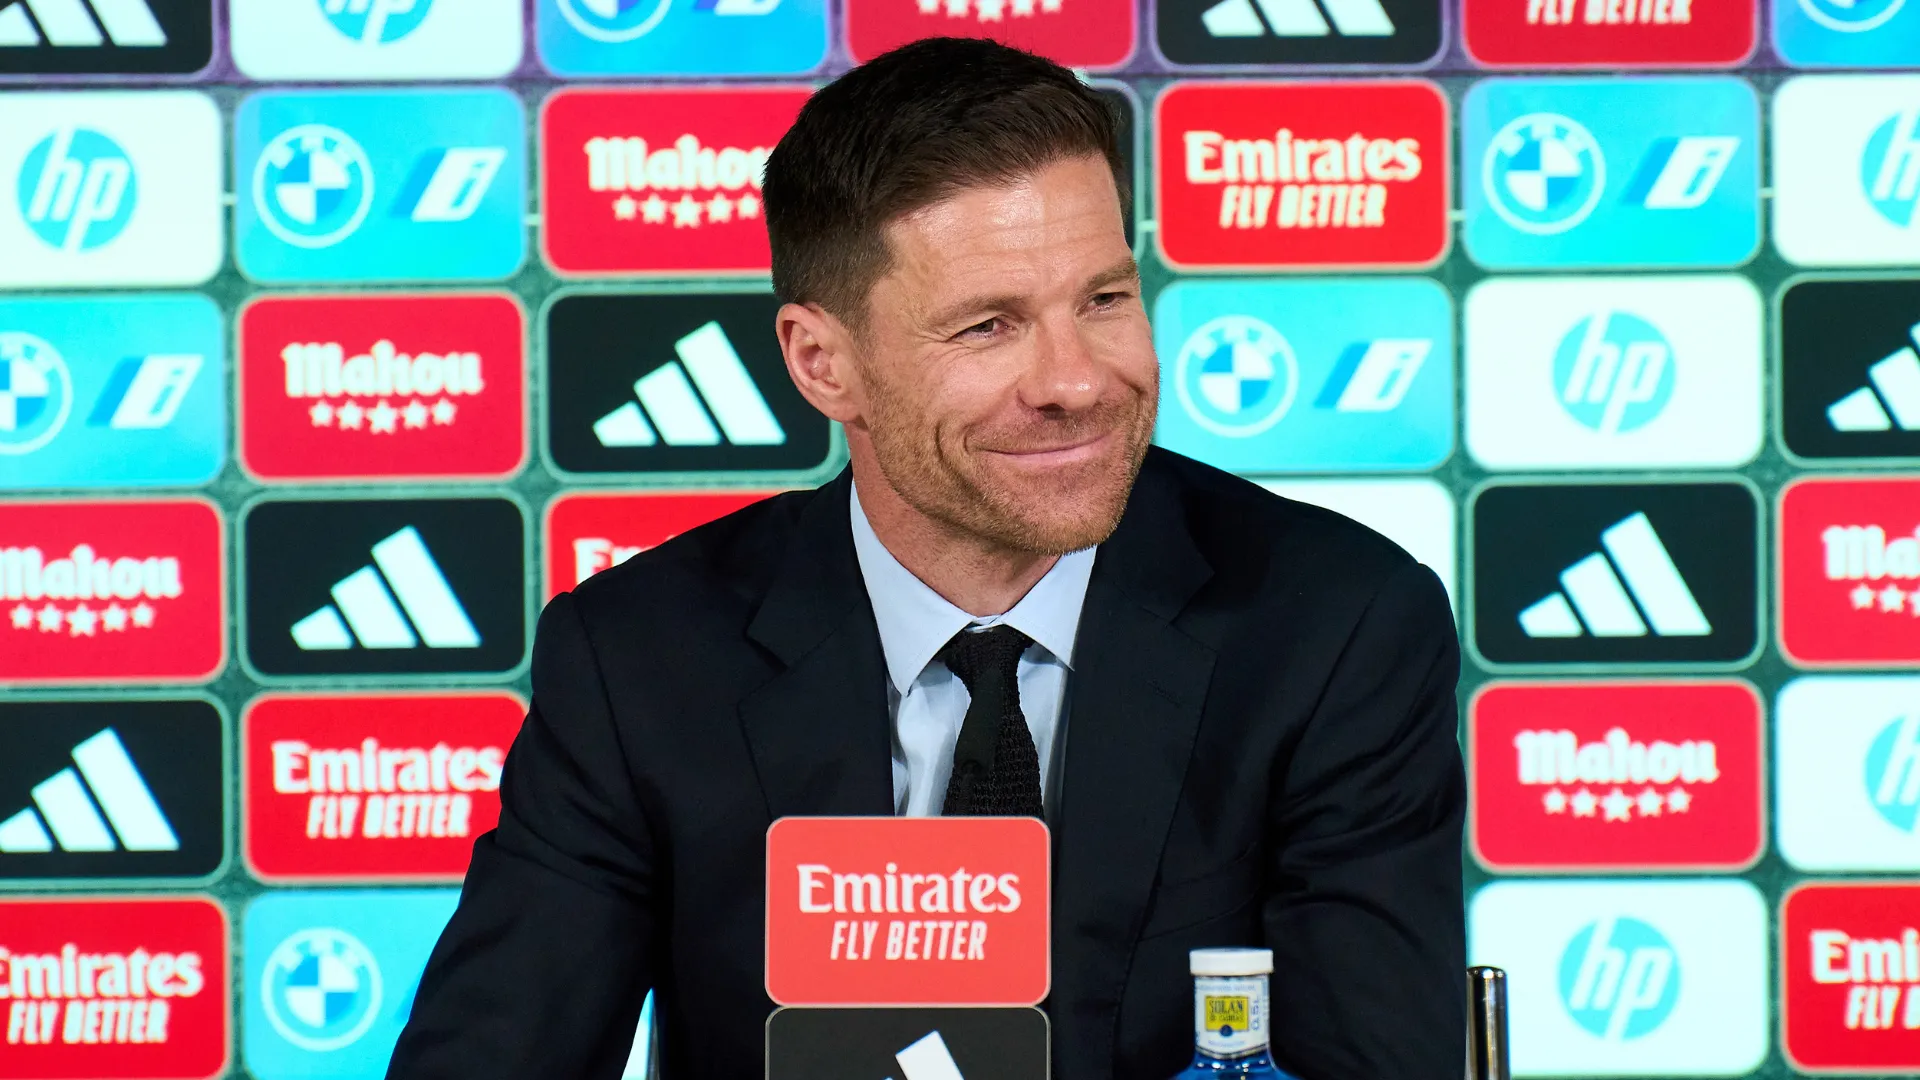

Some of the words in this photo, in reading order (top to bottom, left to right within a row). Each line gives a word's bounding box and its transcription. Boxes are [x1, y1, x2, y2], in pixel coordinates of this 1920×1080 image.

[1184, 128, 1422, 183] Emirates
[27, 126, 131, 252] hp
[1219, 184, 1275, 229] FLY
[1277, 184, 1387, 228] BETTER
[281, 339, 484, 398] Mahou
[1564, 309, 1667, 433] hp
[271, 738, 503, 793] Emirates
[1514, 727, 1720, 784] Mahou
[306, 794, 361, 839] FLY
[362, 794, 472, 839] BETTER
[796, 862, 1021, 913] Emirates
[830, 920, 879, 961] FLY
[885, 920, 988, 961] BETTER
[0, 943, 204, 998] mirates
[1568, 915, 1674, 1040] hp
[7, 1000, 60, 1045] FLY
[62, 1000, 170, 1044] BETTER
[1845, 984, 1901, 1030] FLY
